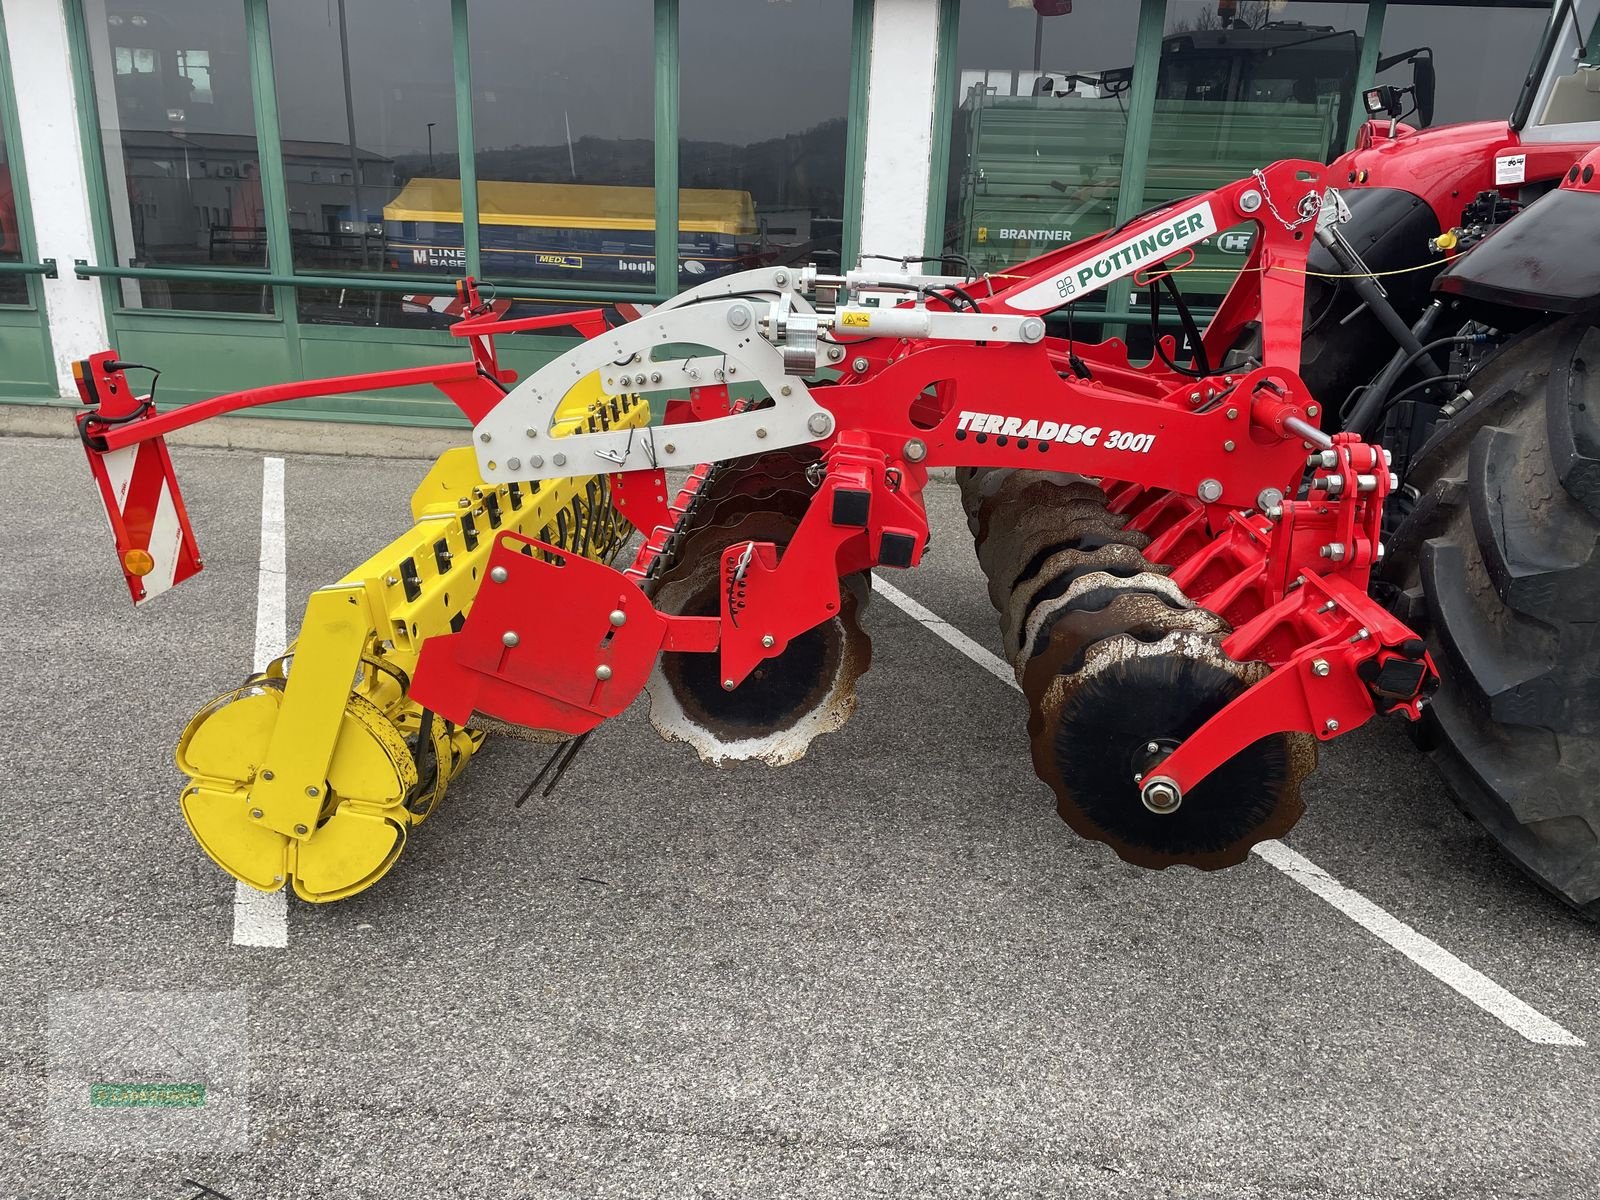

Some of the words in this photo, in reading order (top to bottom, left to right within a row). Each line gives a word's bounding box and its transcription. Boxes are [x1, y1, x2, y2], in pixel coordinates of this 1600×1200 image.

[999, 228, 1072, 241] BRANTNER
[429, 248, 467, 258] LINE
[429, 258, 467, 268] BASE
[956, 410, 1102, 447] TERRADISC
[1103, 430, 1157, 453] 3001
